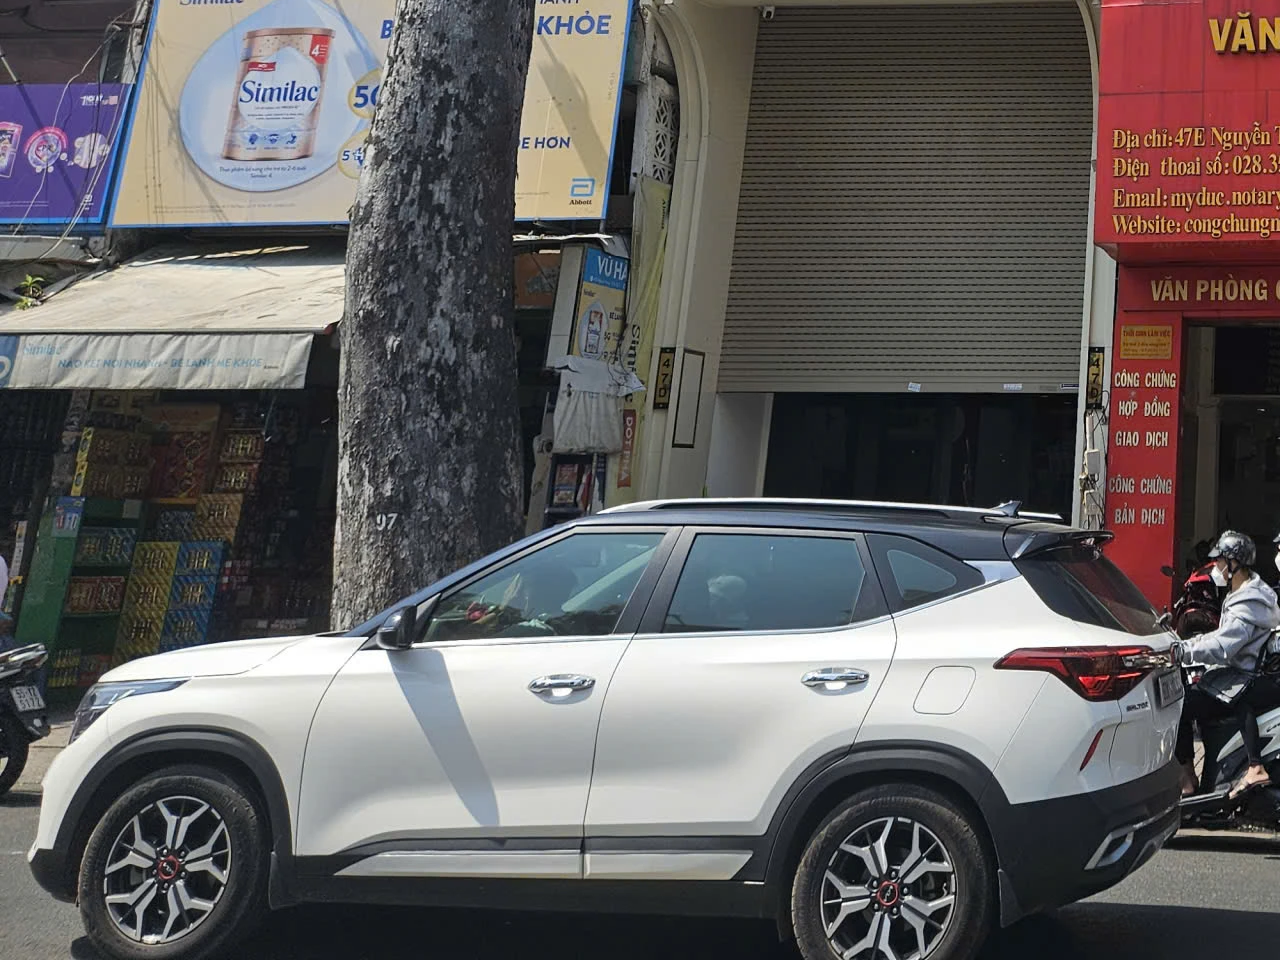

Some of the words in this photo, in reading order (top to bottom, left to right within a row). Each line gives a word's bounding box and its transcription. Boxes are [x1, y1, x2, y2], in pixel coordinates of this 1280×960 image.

[536, 11, 612, 35] KHỎE
[239, 80, 318, 104] Similac
[534, 136, 571, 149] HƠN
[1112, 128, 1140, 153] Địa
[1210, 121, 1271, 151] Nguyễn
[1112, 157, 1150, 181] Điện
[1112, 214, 1181, 234] Website:
[1150, 275, 1188, 301] VĂN
[1196, 274, 1268, 301] PHÒNG
[1114, 369, 1140, 388] CÔNG
[1145, 369, 1177, 388] CHỨNG
[1118, 399, 1138, 419] HỢP
[1144, 396, 1171, 417] ĐỒNG
[1115, 430, 1139, 447] GIAO
[1145, 431, 1169, 450] DỊCH
[1109, 474, 1134, 494] CÔNG
[1140, 474, 1172, 494] CHỨNG
[1114, 503, 1135, 524] BẢN
[1141, 508, 1165, 527] DỊCH
